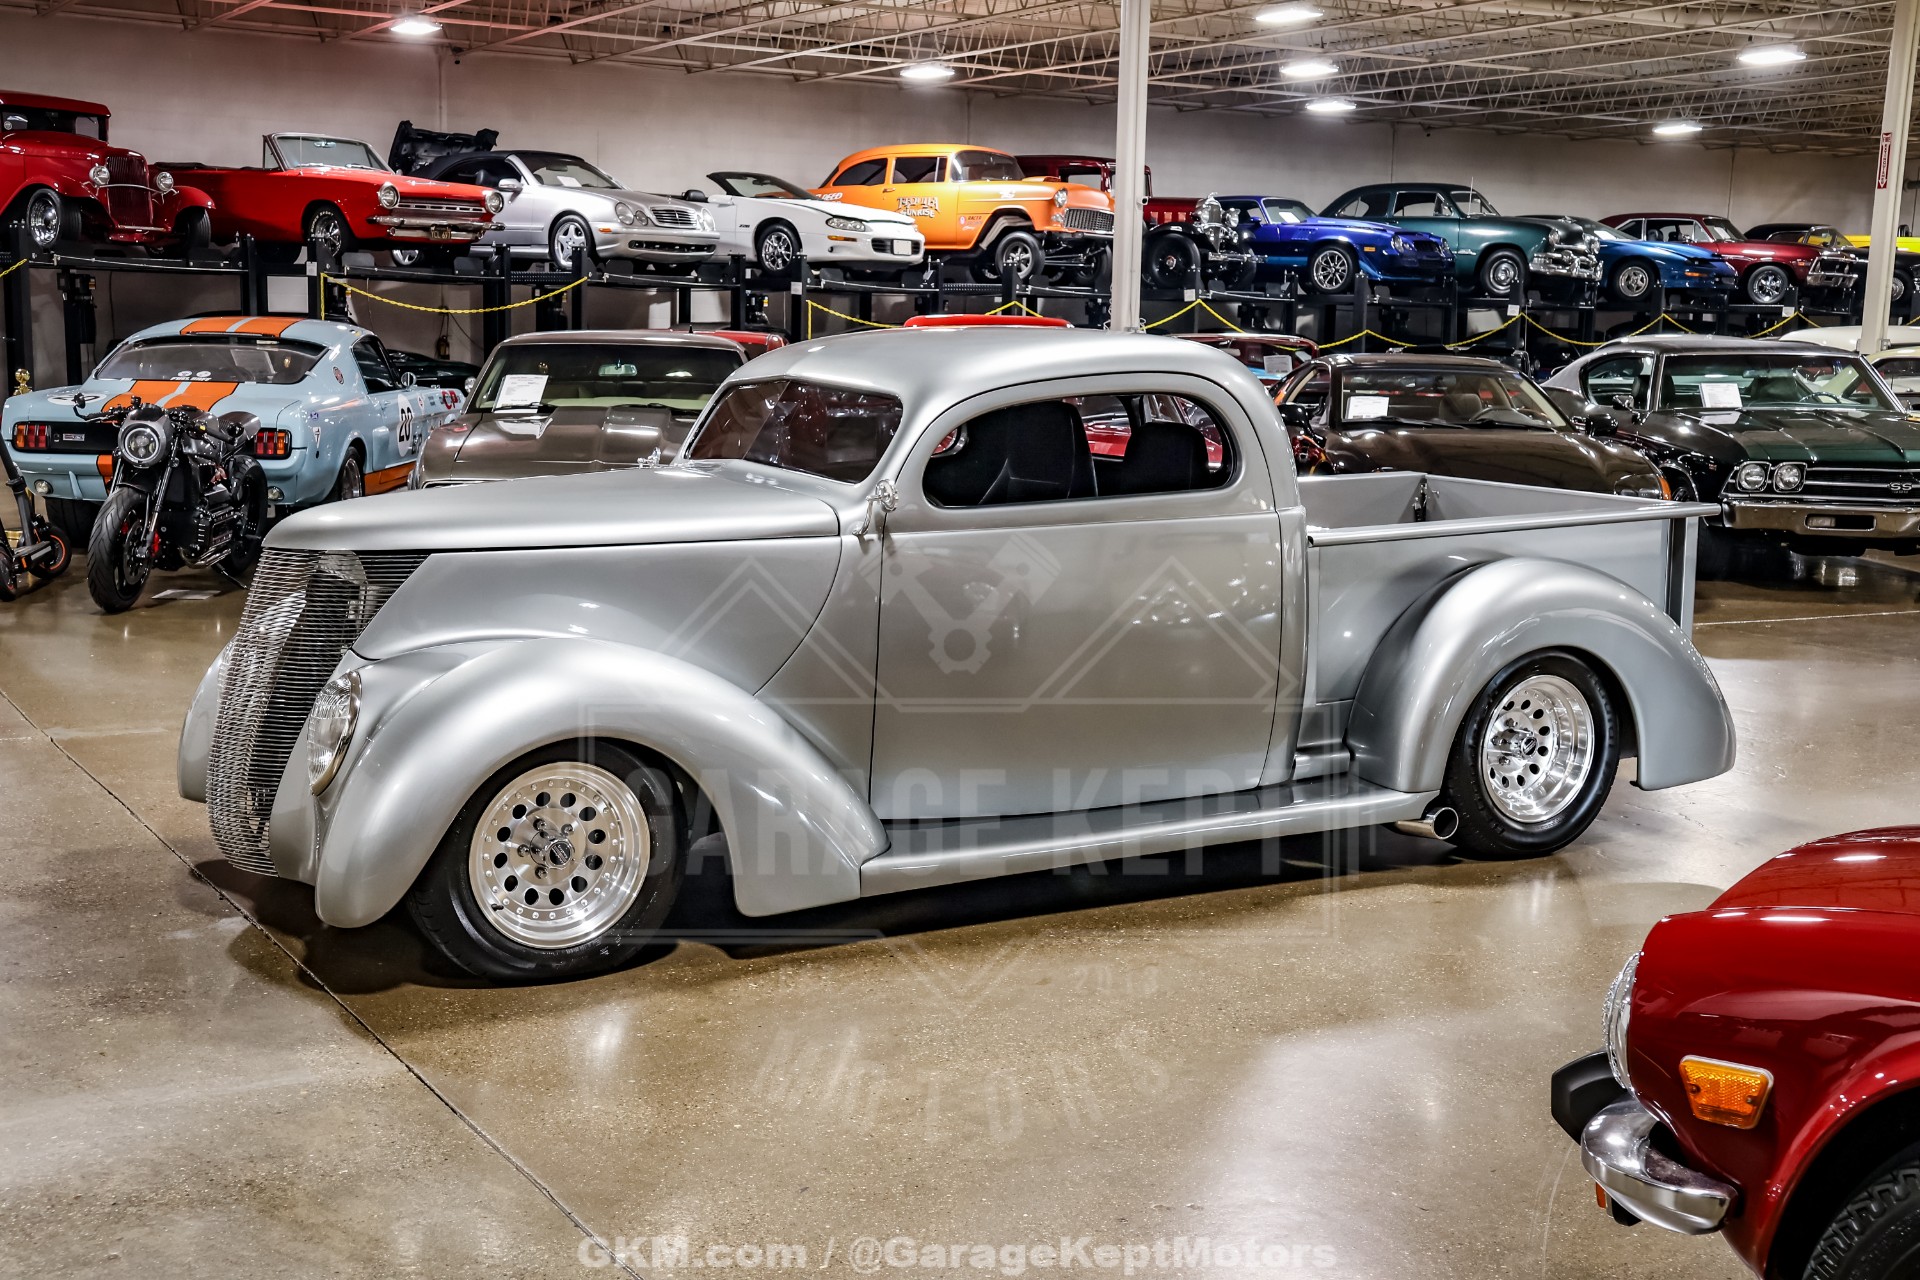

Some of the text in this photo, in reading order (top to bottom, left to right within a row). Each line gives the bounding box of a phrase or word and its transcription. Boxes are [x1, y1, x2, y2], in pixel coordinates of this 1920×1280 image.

[896, 196, 940, 210] TEQUILA
[901, 207, 936, 219] SUNRISE
[398, 406, 414, 442] 20
[1890, 482, 1912, 491] SS
